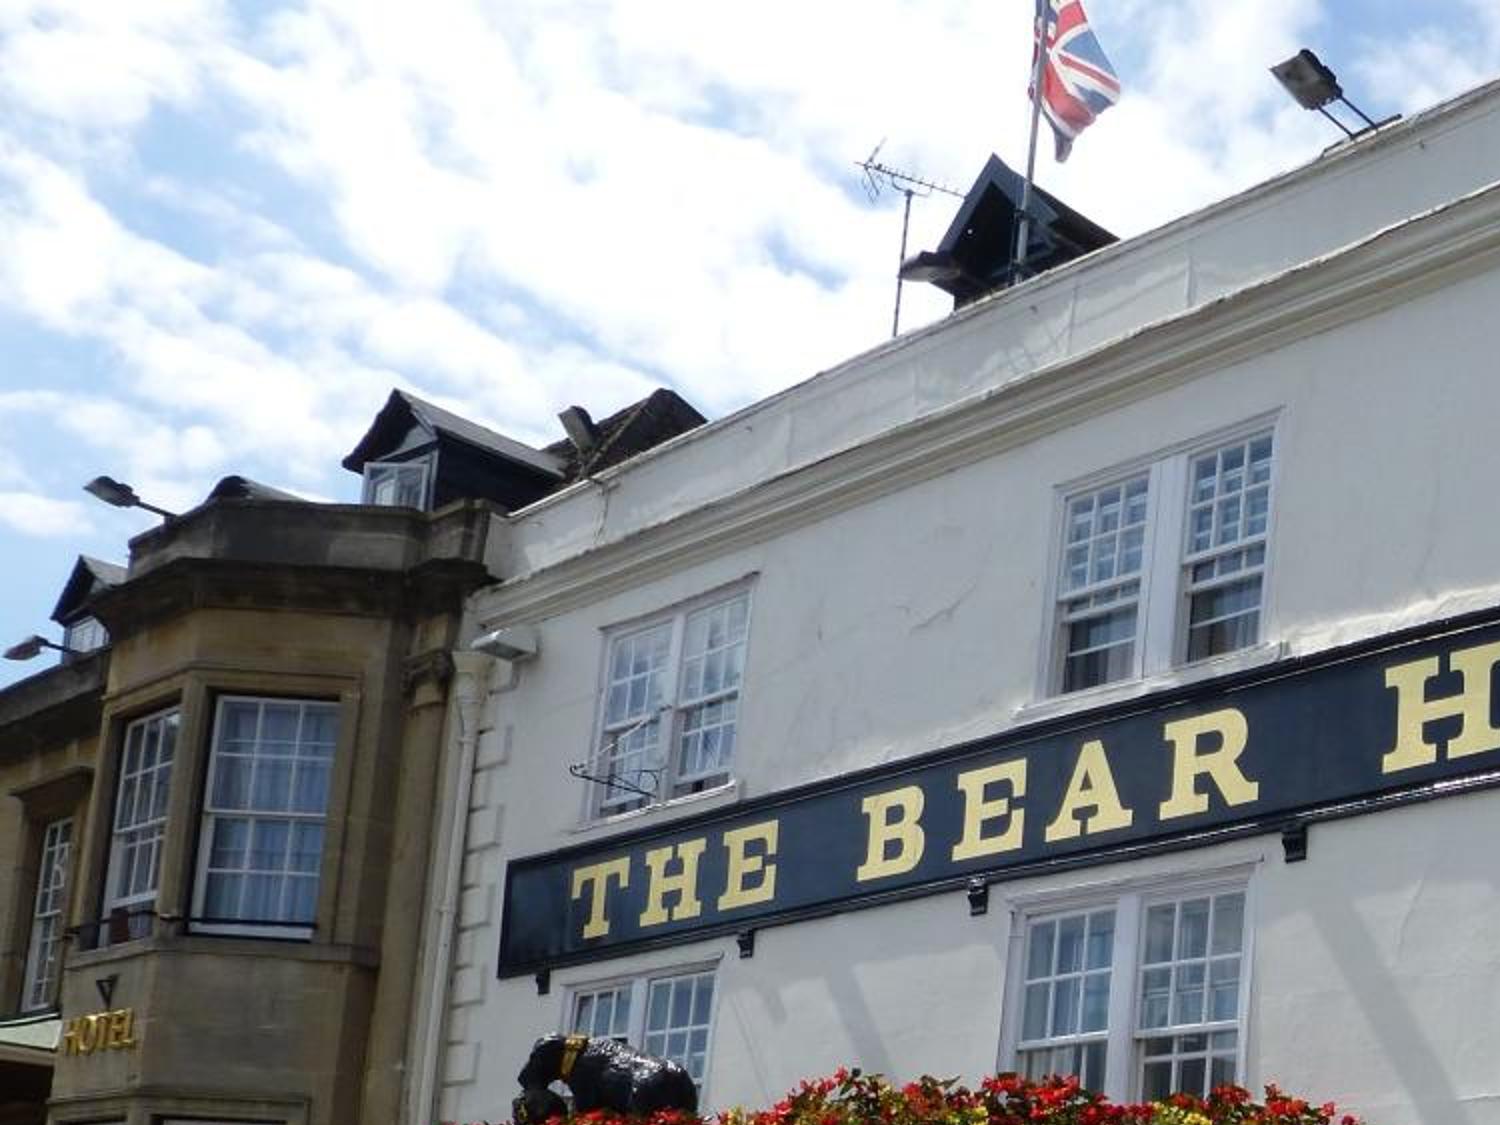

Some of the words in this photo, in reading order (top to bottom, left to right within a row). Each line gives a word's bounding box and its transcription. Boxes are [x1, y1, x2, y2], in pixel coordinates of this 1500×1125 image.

[570, 819, 780, 939] THE
[856, 706, 1260, 882] BEAR
[64, 1007, 137, 1057] HOTEL
